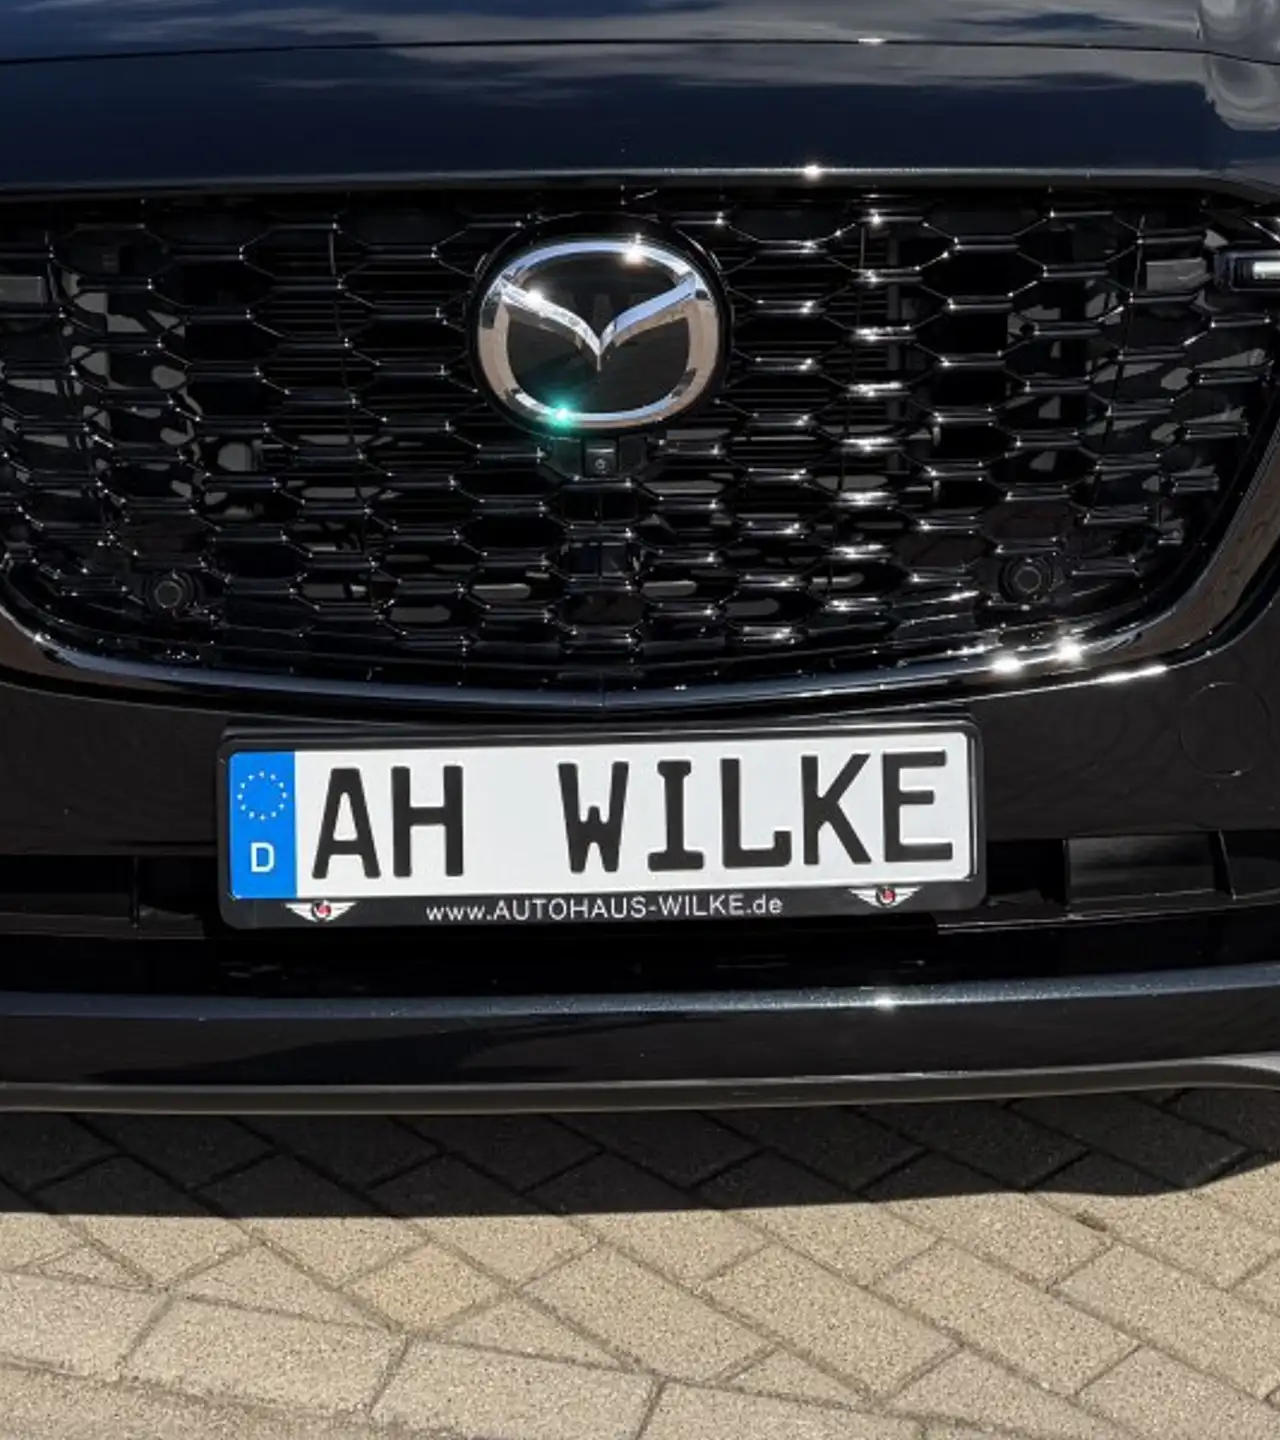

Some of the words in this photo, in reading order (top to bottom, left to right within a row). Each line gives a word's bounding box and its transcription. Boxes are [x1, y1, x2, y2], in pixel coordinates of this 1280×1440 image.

[311, 765, 464, 880] AH
[557, 750, 955, 874] WILKE
[250, 842, 276, 873] D
[425, 894, 783, 921] www.AUTOHAUS-WILKE.de
